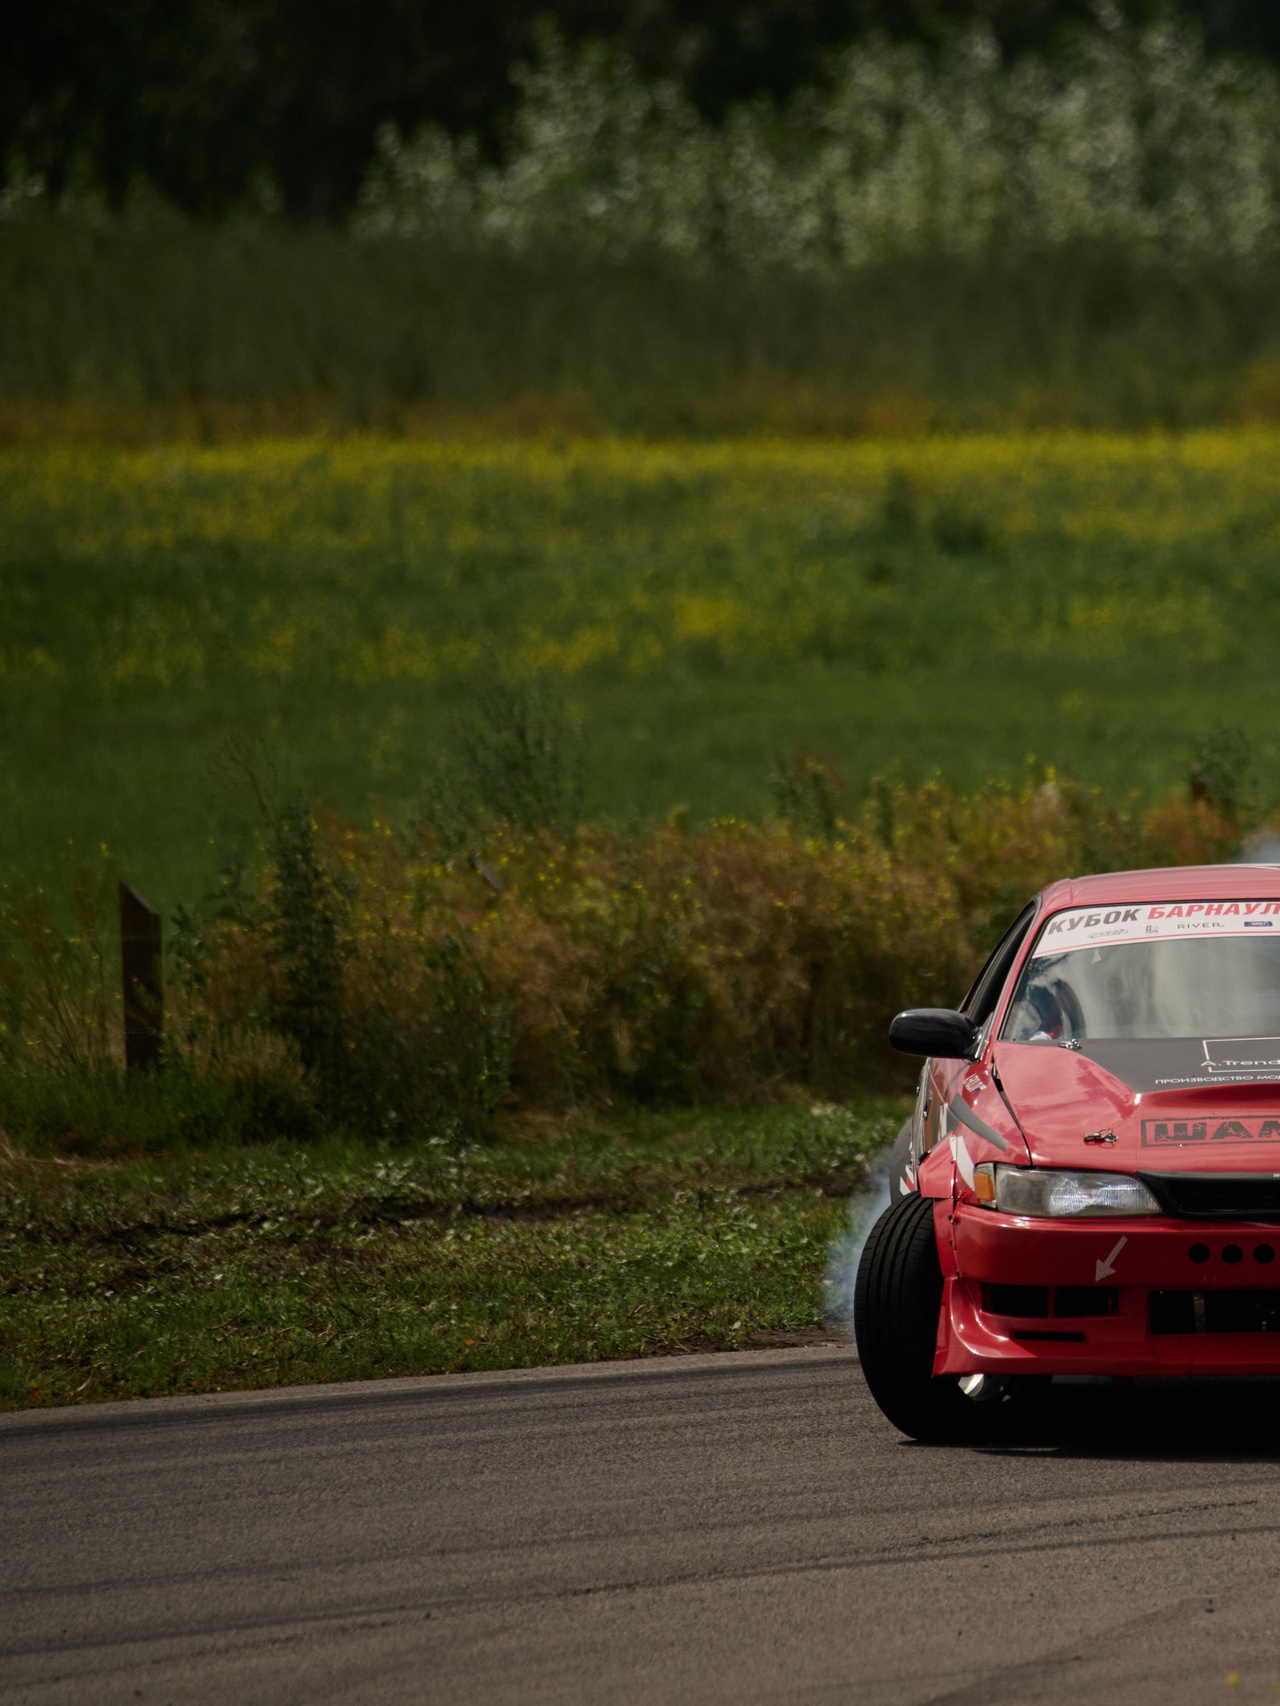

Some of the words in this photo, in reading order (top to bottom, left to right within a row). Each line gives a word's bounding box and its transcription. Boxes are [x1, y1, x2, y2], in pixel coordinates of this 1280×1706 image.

[1048, 908, 1142, 935] КУБОК
[1177, 922, 1224, 930] RIVER
[1155, 1075, 1254, 1085] ПРОИЗВОДСТВО
